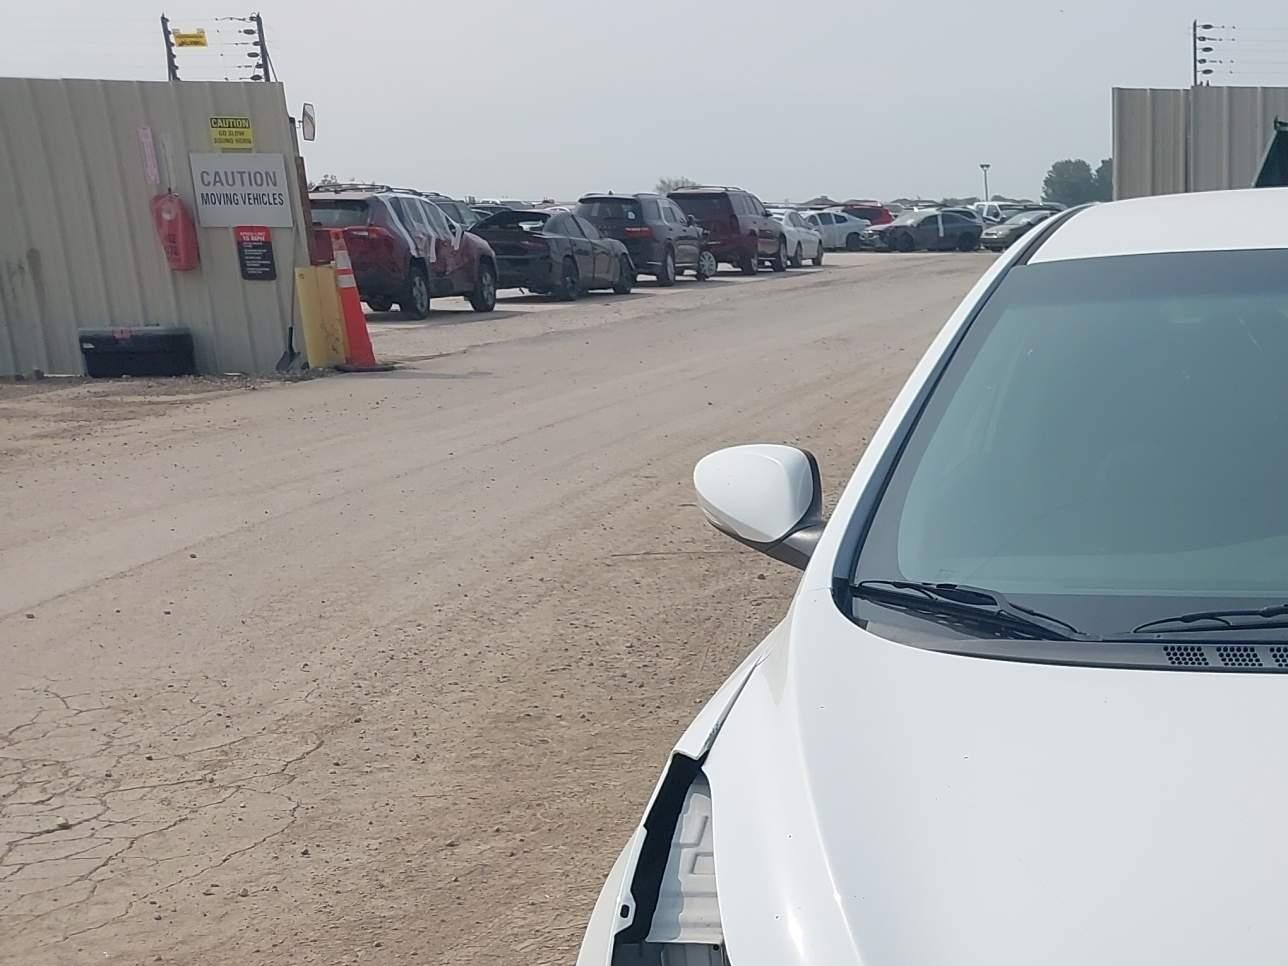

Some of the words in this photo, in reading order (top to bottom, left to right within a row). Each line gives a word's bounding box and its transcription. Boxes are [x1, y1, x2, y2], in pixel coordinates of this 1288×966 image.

[211, 118, 249, 128] CAUTION
[200, 170, 278, 187] CAUTION
[201, 192, 239, 206] MOVING
[241, 192, 284, 206] VEHICLES
